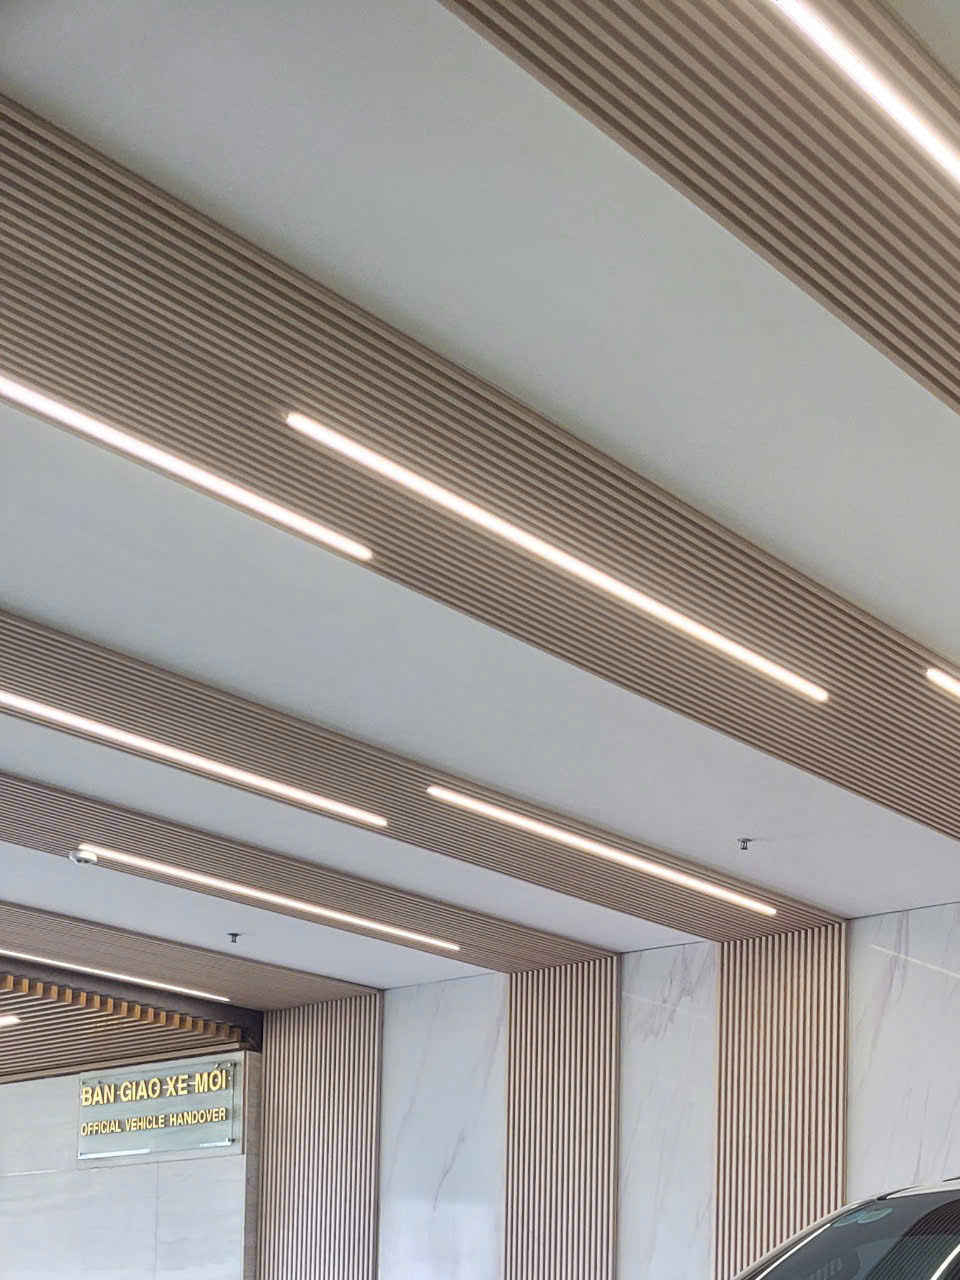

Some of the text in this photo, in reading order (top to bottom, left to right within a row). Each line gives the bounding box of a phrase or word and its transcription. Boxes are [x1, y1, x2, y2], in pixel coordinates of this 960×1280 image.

[120, 1078, 160, 1102] GIAO
[166, 1074, 188, 1096] XE
[80, 1107, 226, 1136] OFFICIAL VEHICLE HANDOVER
